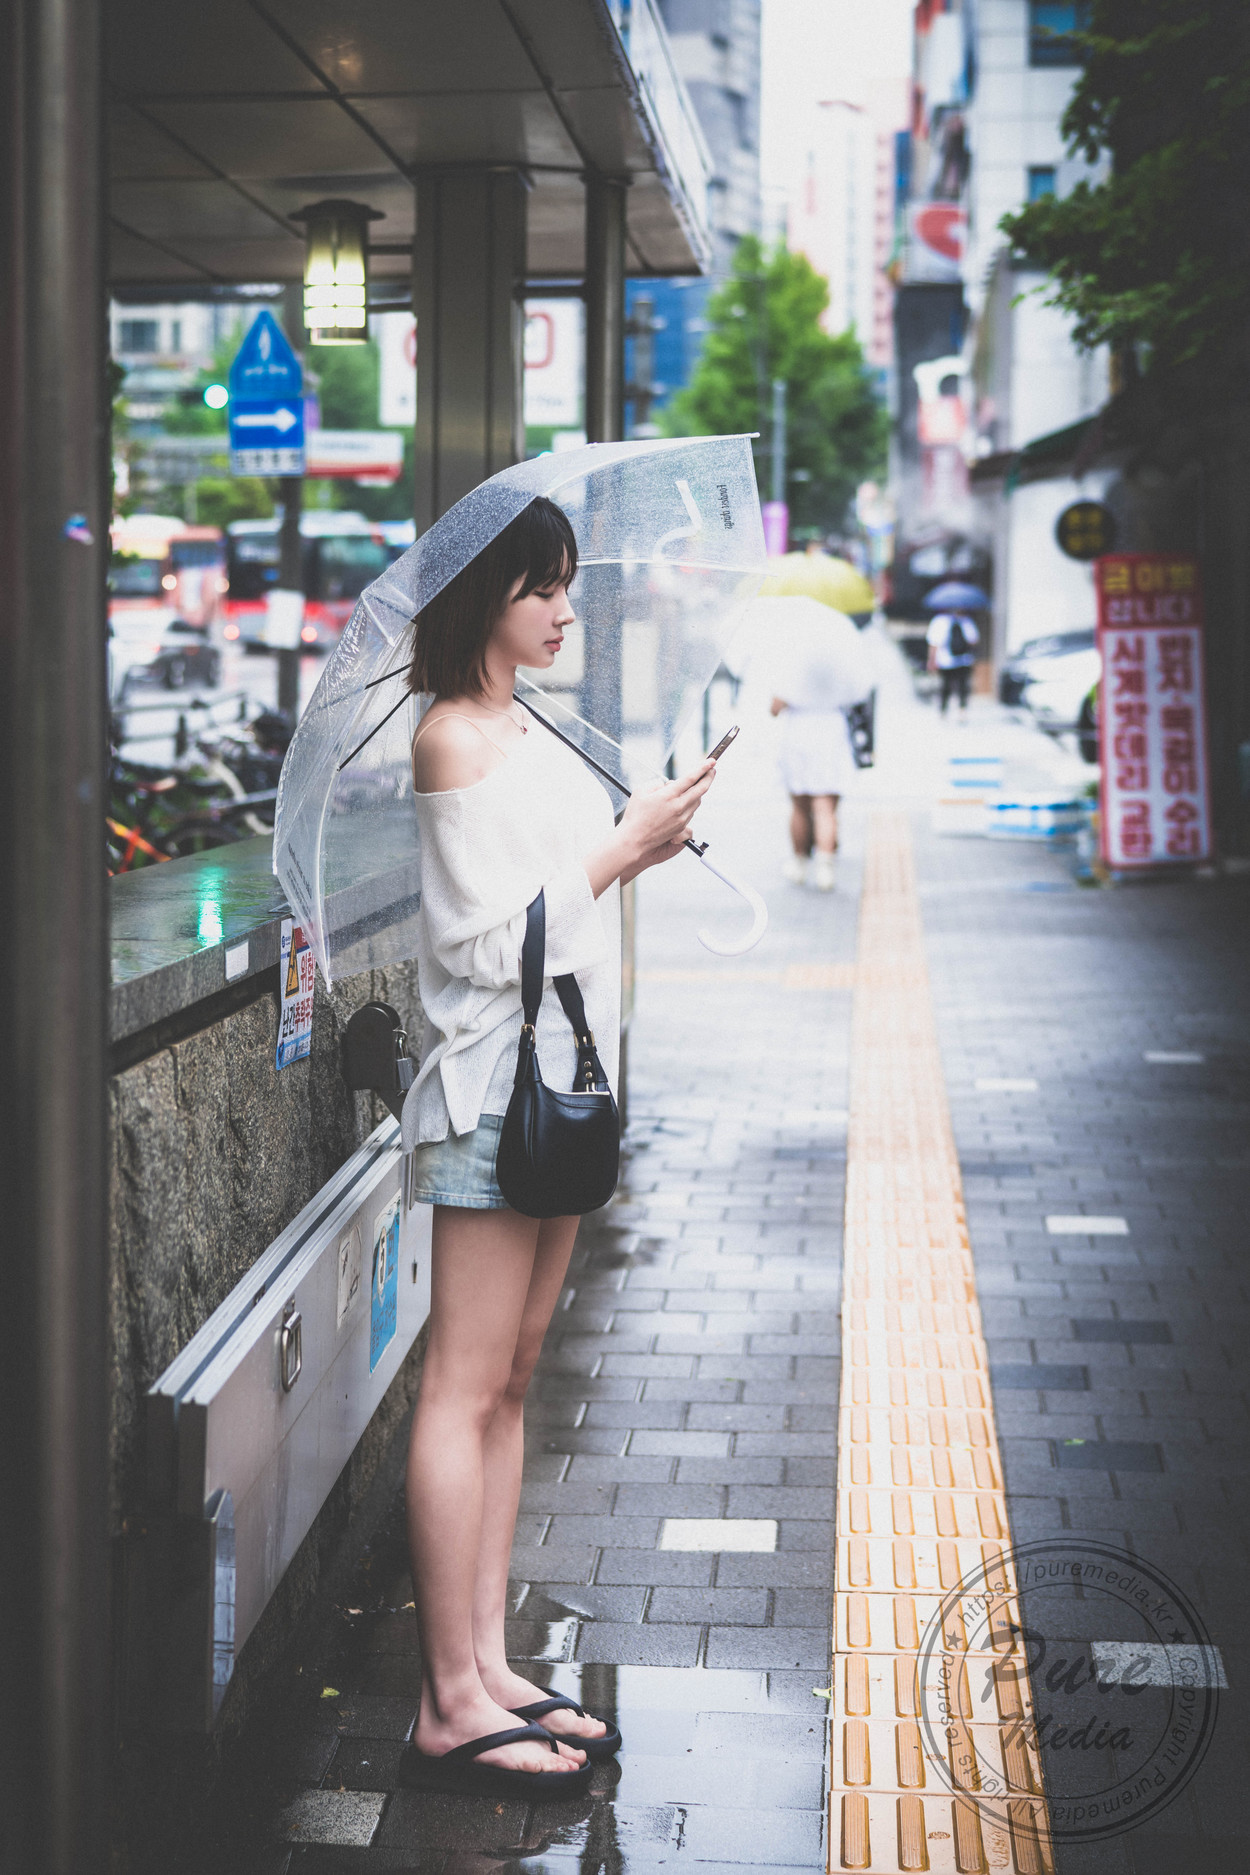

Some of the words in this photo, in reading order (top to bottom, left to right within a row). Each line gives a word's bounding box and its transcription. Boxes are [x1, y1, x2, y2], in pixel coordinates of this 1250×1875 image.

[1107, 595, 1193, 624] 삽니다
[1164, 799, 1201, 857] 수리
[300, 951, 314, 993] 위험
